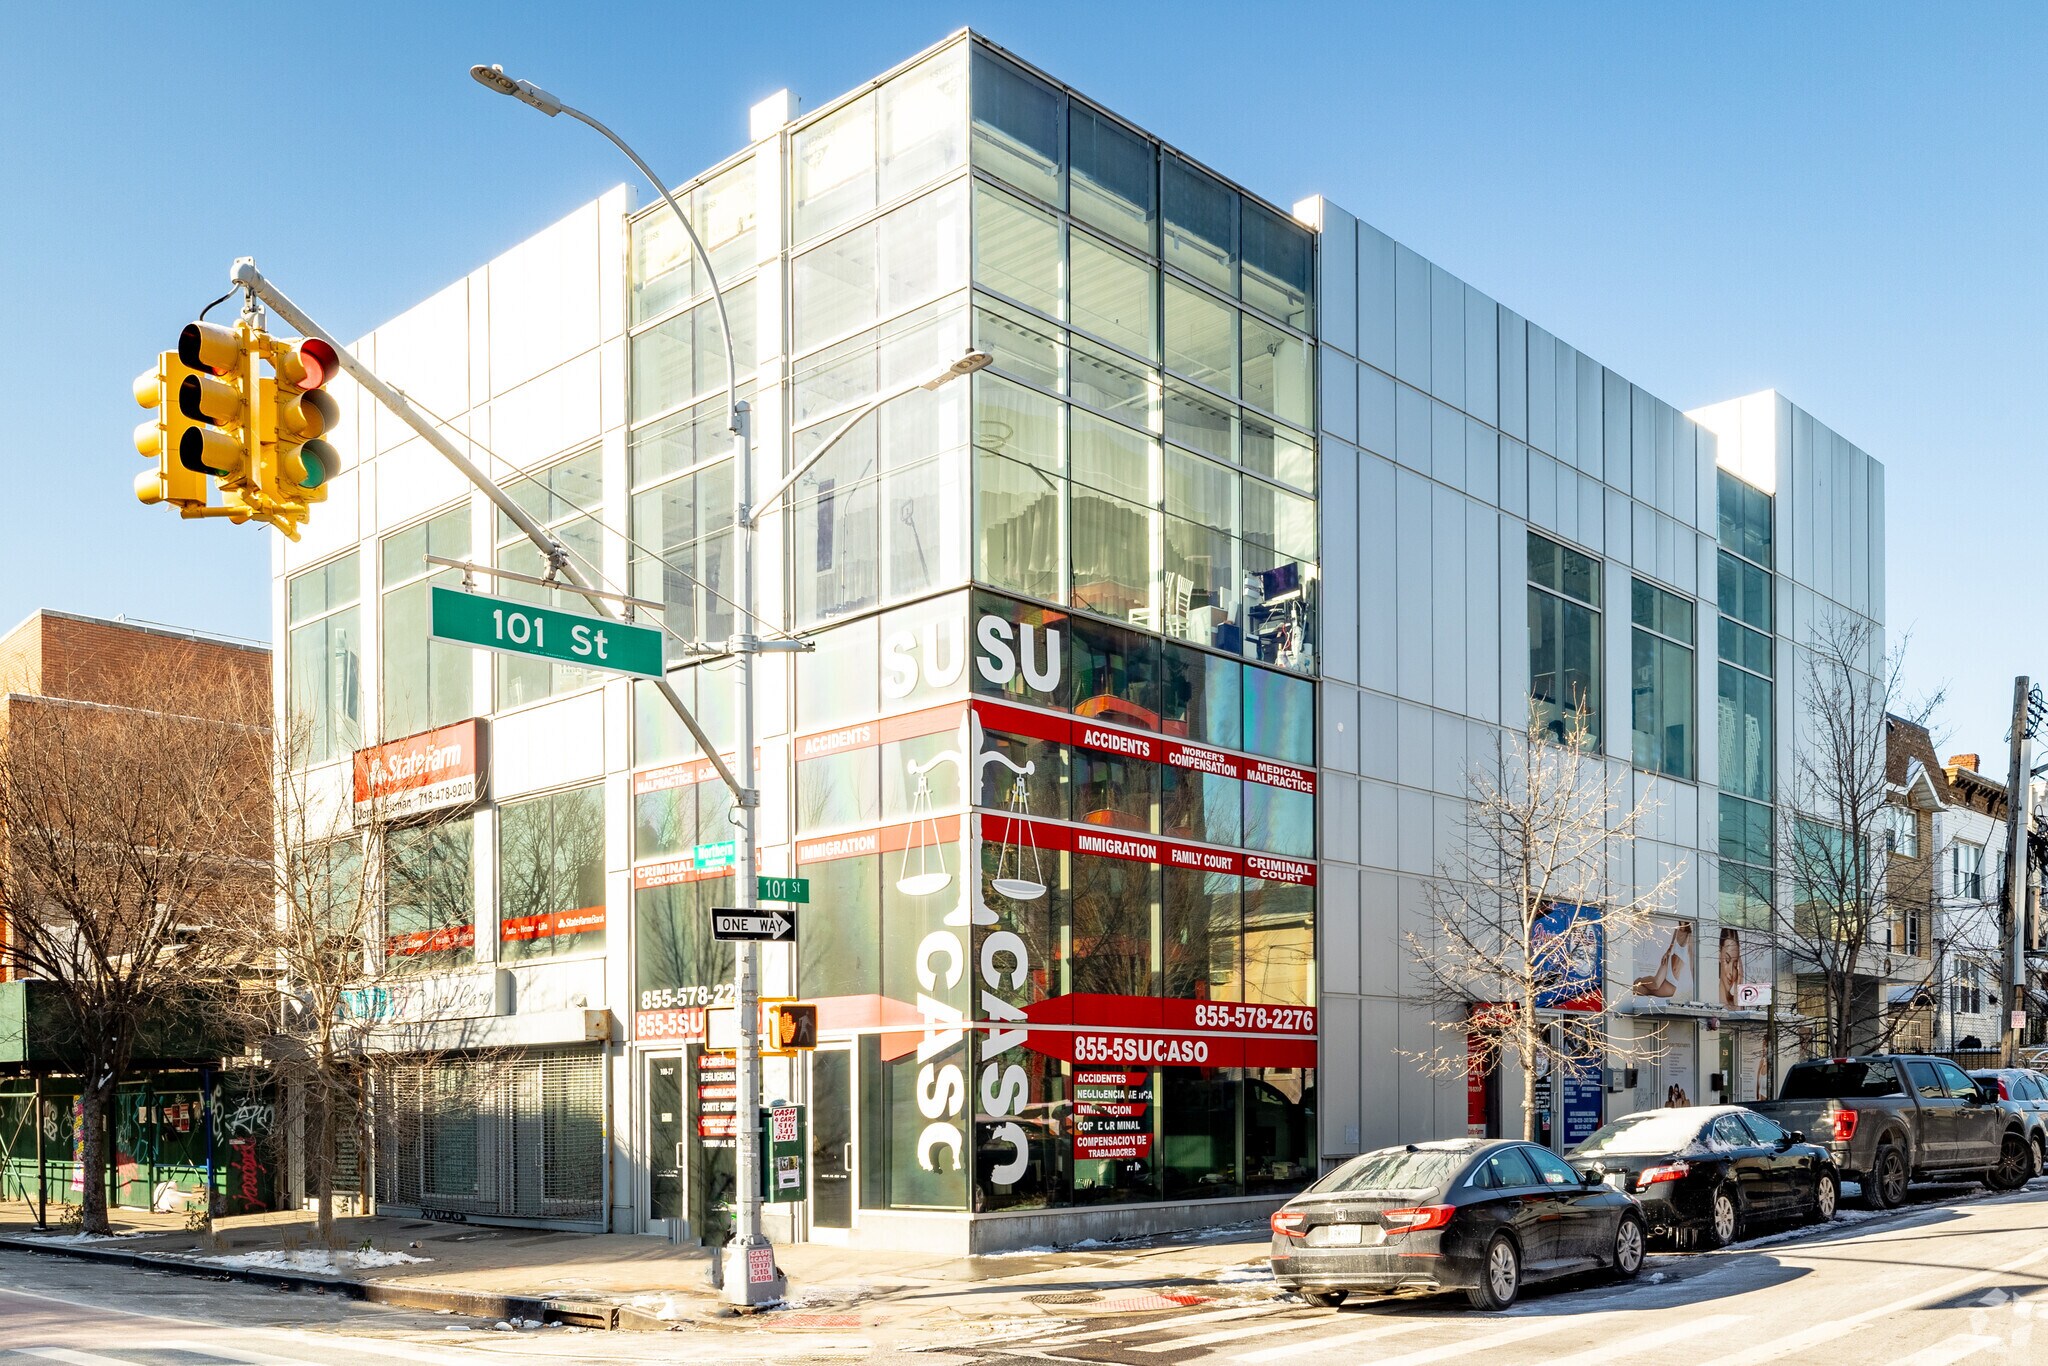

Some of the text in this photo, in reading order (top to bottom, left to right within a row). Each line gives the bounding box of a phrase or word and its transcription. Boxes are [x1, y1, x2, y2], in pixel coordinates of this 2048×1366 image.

[493, 609, 608, 659] 101 St
[881, 616, 965, 699] SU
[976, 615, 1061, 692] SU
[804, 726, 871, 755] ACCIDENTS
[1084, 729, 1150, 757] ACCIDENTS
[1182, 746, 1225, 762] WORKER'S
[645, 766, 684, 780] MEDICAL
[1169, 752, 1237, 777] COMPENSATION
[1258, 762, 1303, 780] MEDICAL
[637, 772, 694, 791] MALPRACTICE
[1247, 769, 1313, 793] MALPRACTICE
[419, 781, 473, 806] 718-478-9200
[698, 844, 733, 860] Northern
[801, 835, 876, 860] IMMIGRATION
[1078, 835, 1157, 859] IMMIGRATION
[636, 860, 692, 878] CRIMINAL
[1171, 849, 1232, 870] FAMILY COURT
[1247, 857, 1311, 876] CRIMINAL
[646, 873, 686, 886] COURT
[1260, 869, 1303, 882] COURT
[766, 880, 800, 898] 101 St
[520, 925, 534, 933] Home
[723, 918, 783, 932] ONE WAY
[1195, 1004, 1314, 1030] 855-578-2276
[1075, 1036, 1208, 1062] 855-5SUCASO
[1077, 1073, 1126, 1083] ACCIDENTES
[1077, 1089, 1125, 1099] NEGLIGENCIA
[774, 1109, 796, 1117] CASH
[1137, 1135, 1146, 1145] DE
